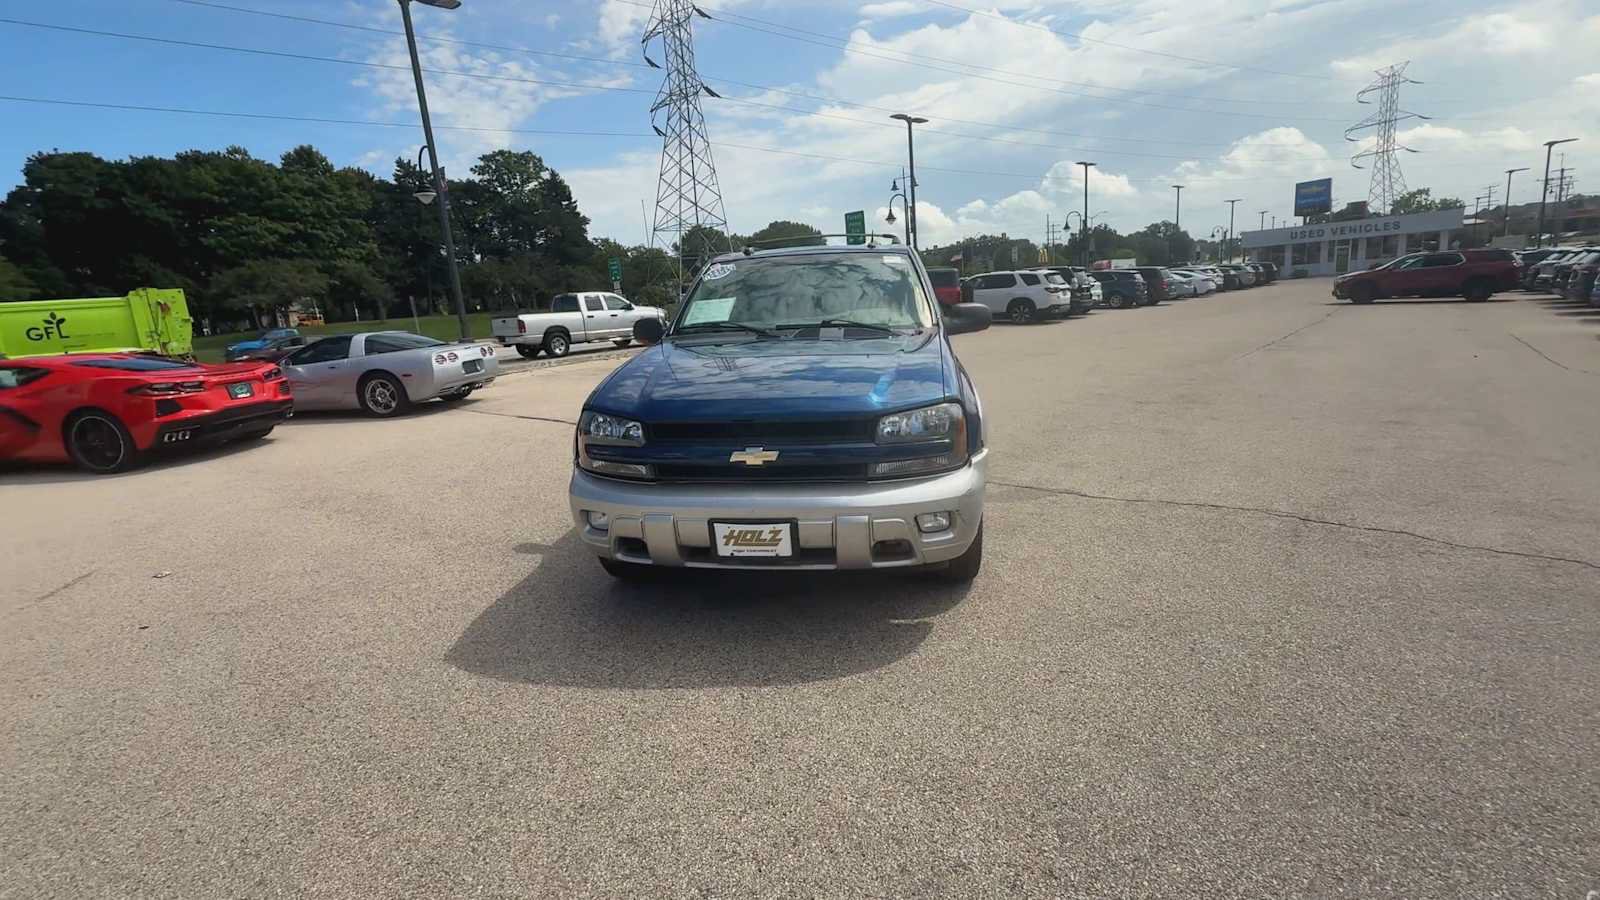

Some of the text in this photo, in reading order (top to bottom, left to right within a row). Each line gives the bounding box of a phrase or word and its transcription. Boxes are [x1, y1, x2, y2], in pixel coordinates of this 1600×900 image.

[1290, 221, 1401, 240] USED VEHICLES
[25, 315, 70, 341] GFL
[723, 529, 783, 546] HOLZ
